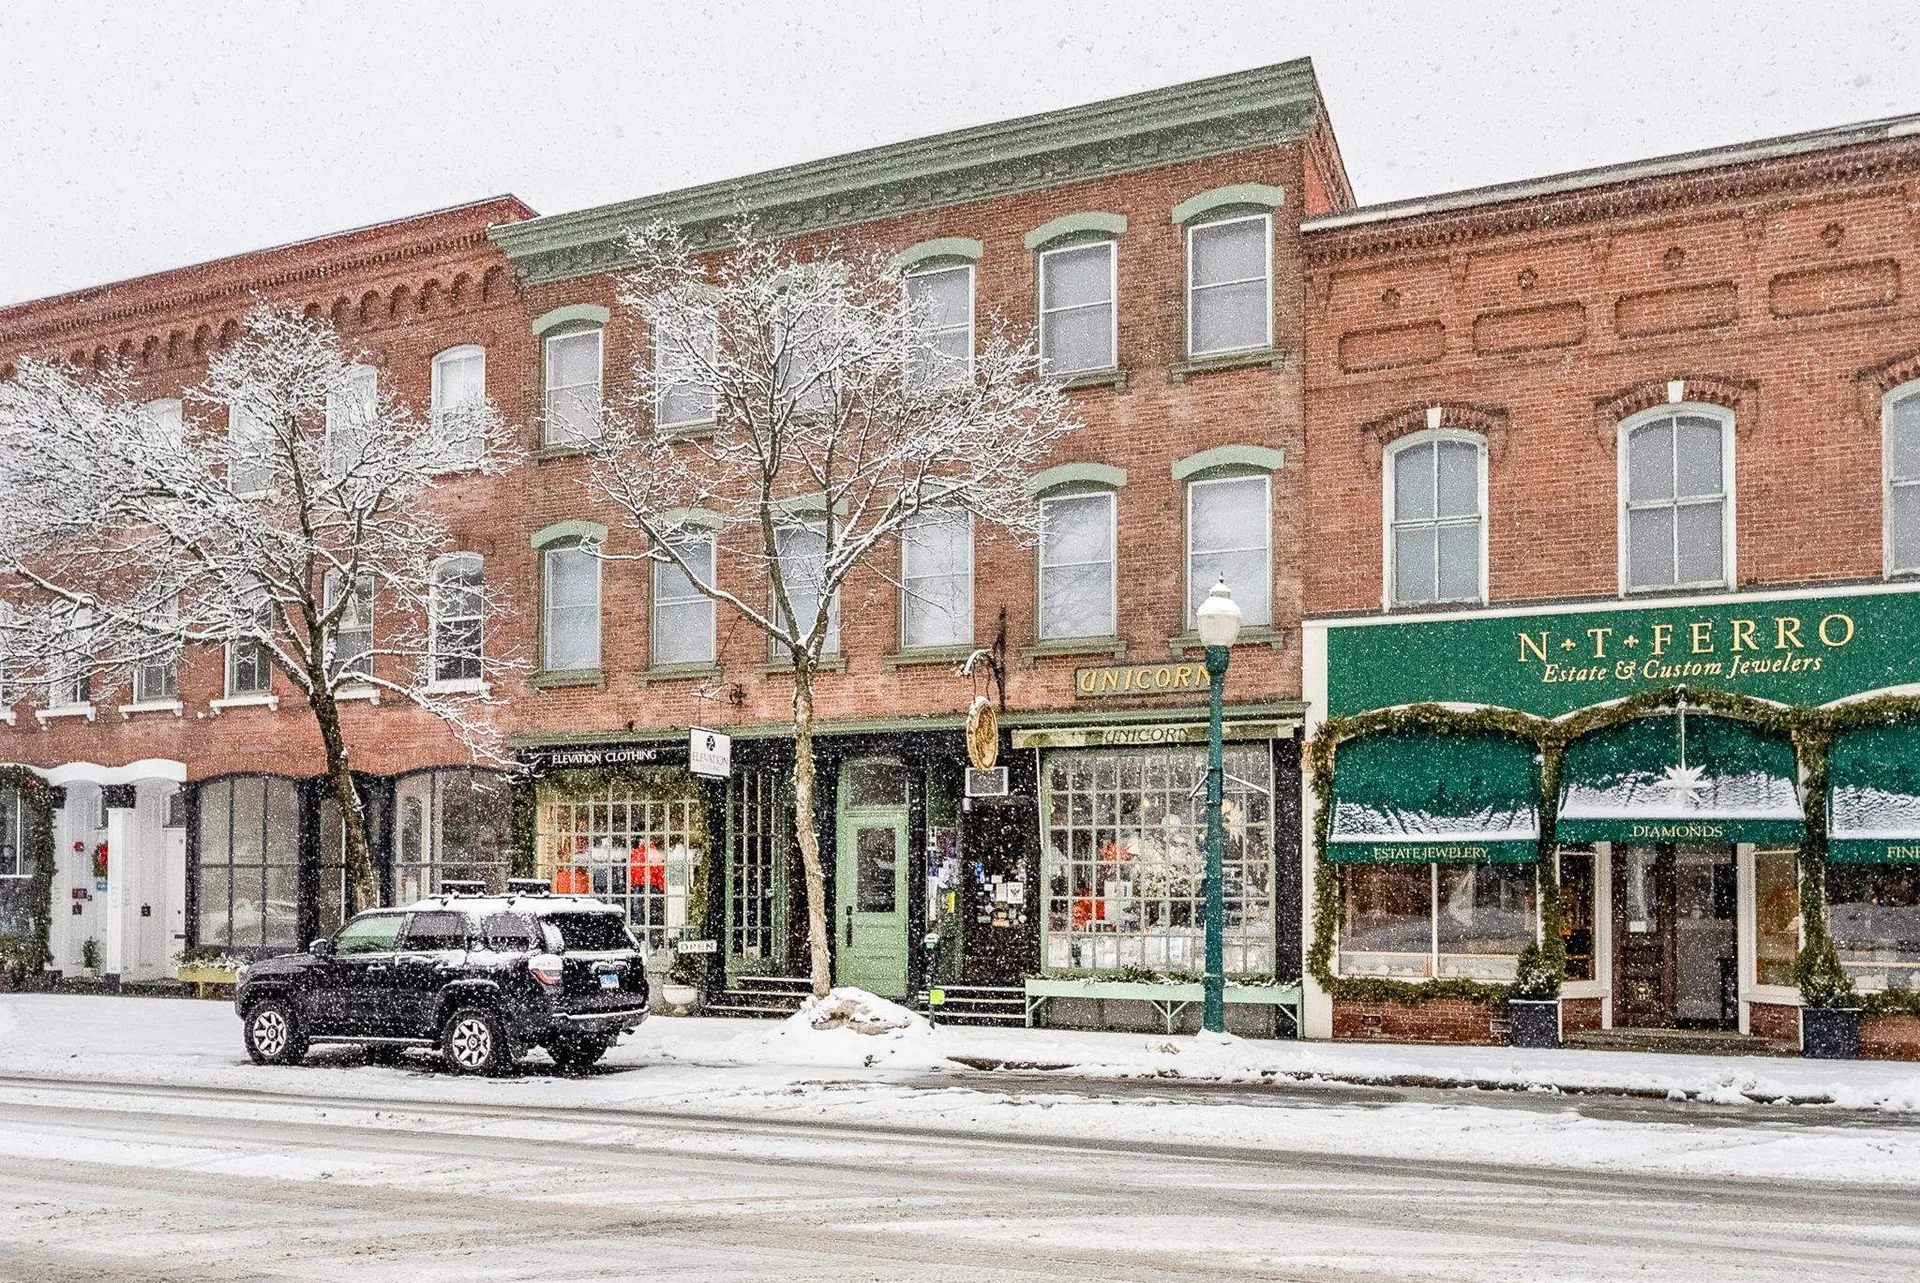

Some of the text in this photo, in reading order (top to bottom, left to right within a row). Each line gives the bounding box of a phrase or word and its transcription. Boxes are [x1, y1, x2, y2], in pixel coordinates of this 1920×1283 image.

[1518, 613, 1855, 662] N T FERRO
[1542, 654, 1823, 684] Estate & Custom Jewelers
[1080, 664, 1211, 692] UNICORN
[1104, 728, 1189, 744] UNICORN
[552, 750, 657, 765] ELEVATION CLOTHING
[1633, 825, 1723, 838] DIAMONDS
[1374, 847, 1489, 860] ESTATE JEWELERY
[680, 942, 714, 951] OPEN
